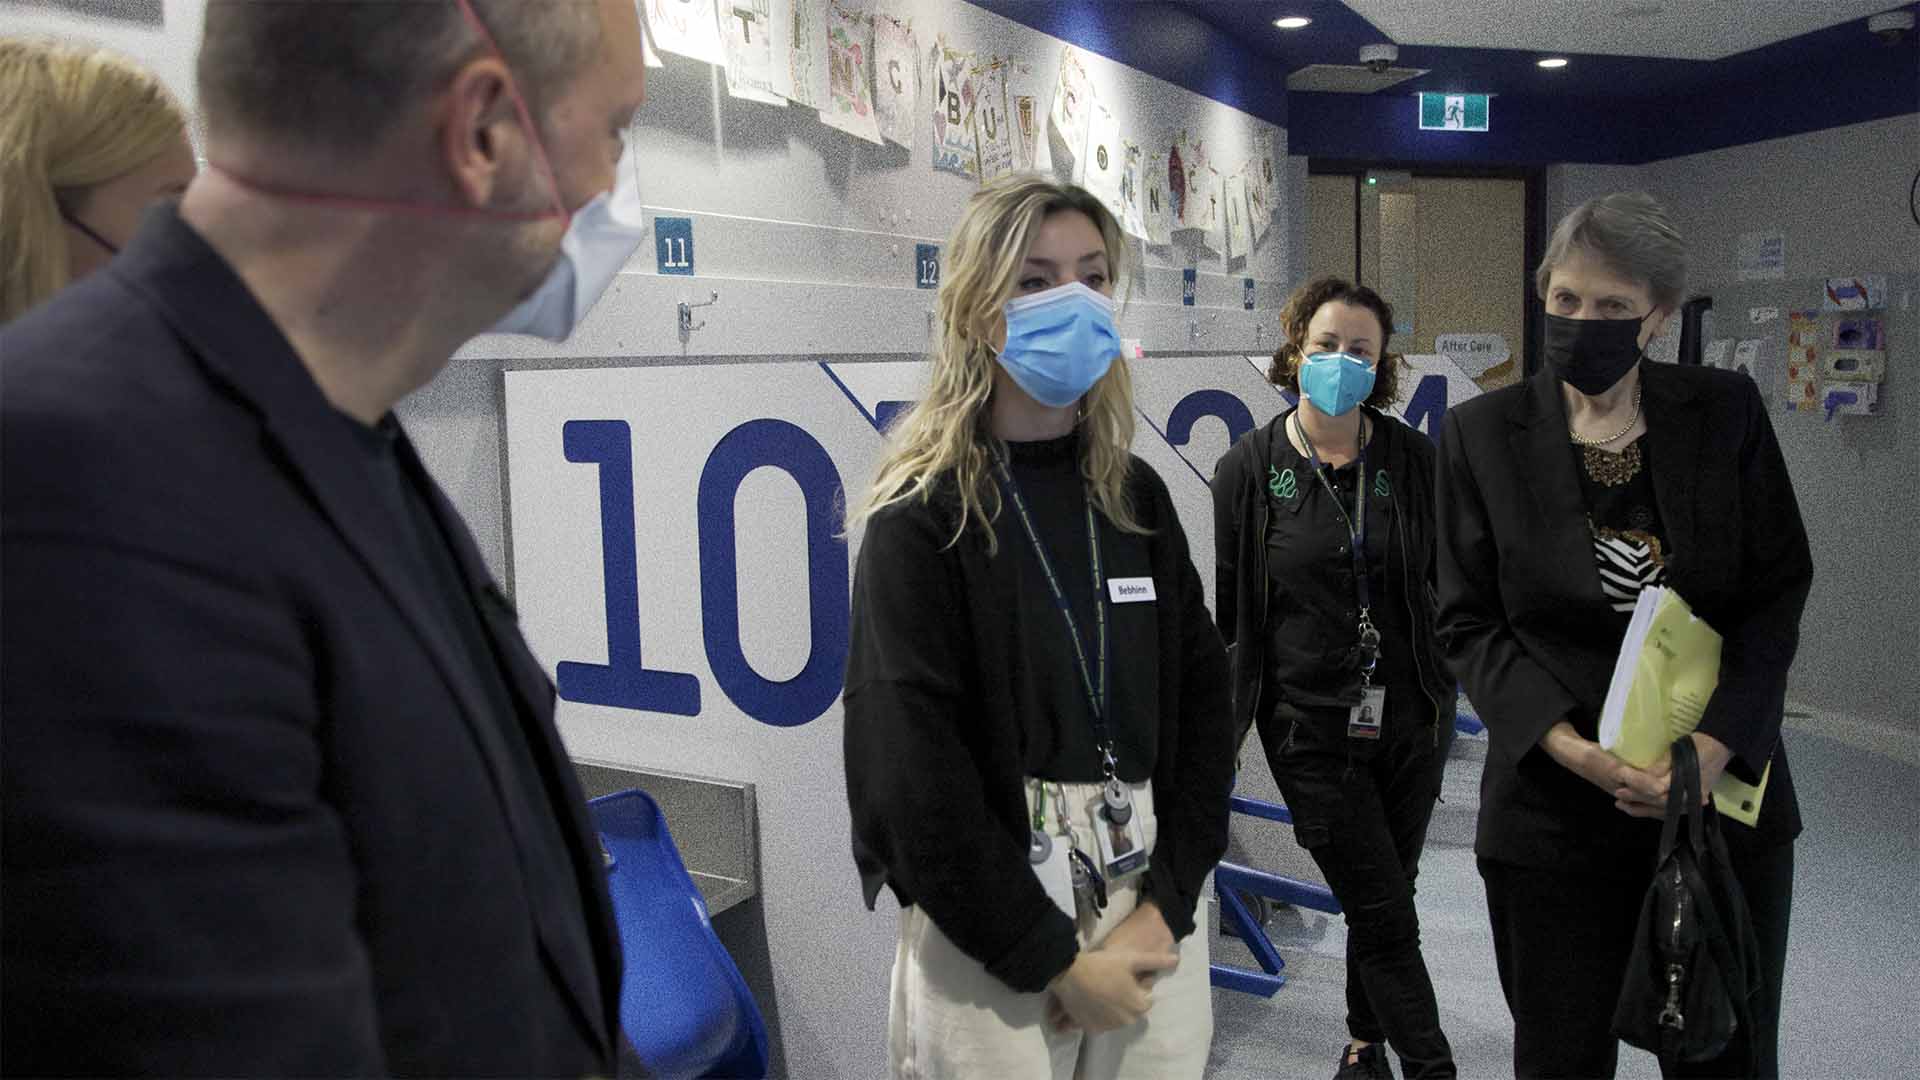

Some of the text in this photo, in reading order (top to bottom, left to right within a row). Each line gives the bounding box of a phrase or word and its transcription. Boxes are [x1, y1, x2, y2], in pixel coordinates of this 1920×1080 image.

[947, 90, 961, 126] B
[664, 238, 689, 268] 11
[920, 260, 937, 284] 12
[1442, 339, 1468, 353] After
[556, 418, 849, 727] 10
